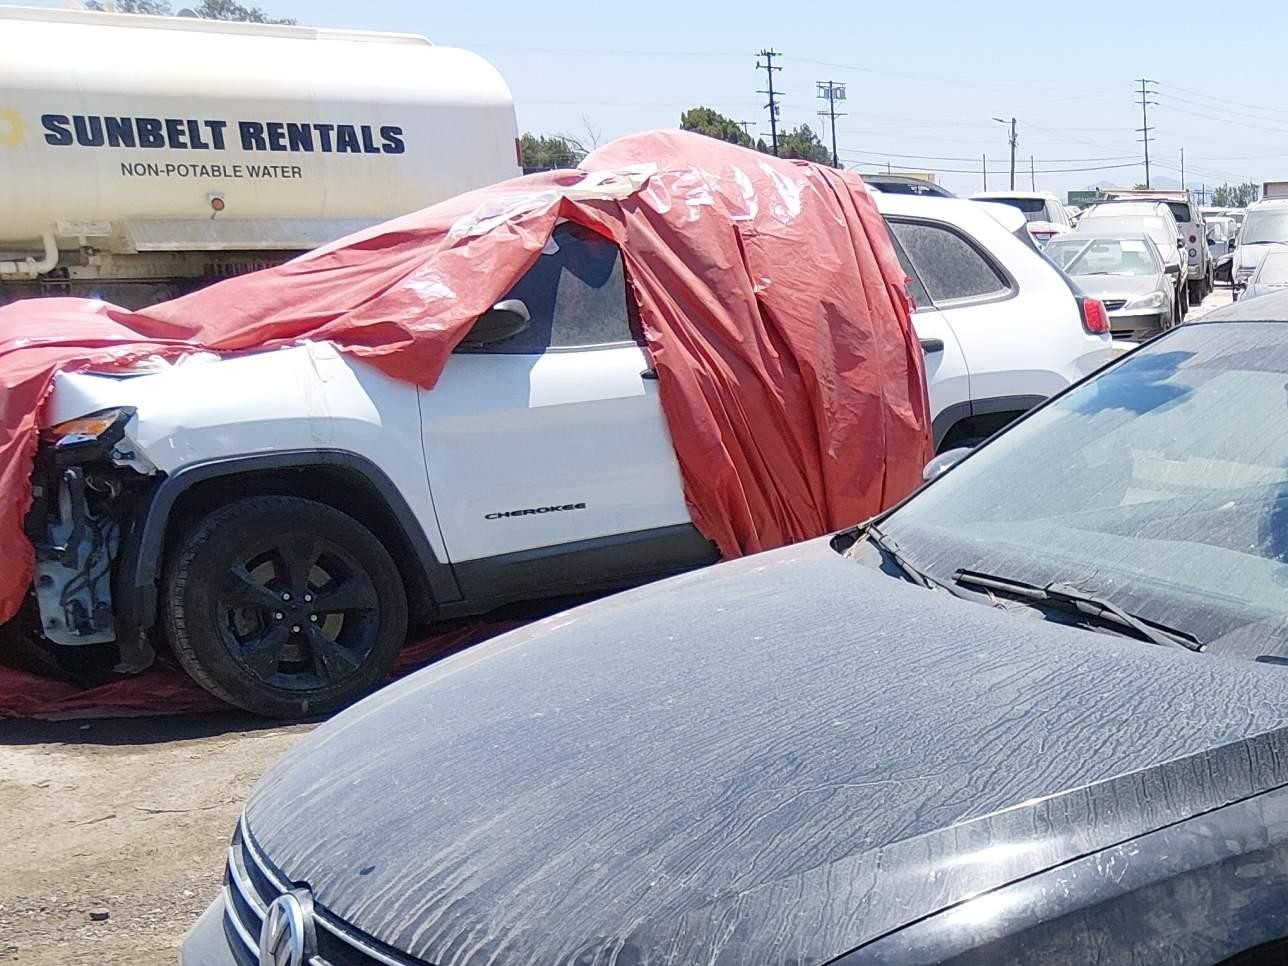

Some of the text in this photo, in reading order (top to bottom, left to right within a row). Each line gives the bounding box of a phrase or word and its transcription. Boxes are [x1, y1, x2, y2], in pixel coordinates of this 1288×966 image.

[41, 114, 406, 154] SUNBELT RENTALS
[121, 162, 302, 179] NON-POTABLE WATER
[484, 502, 587, 520] CHEROKEE
